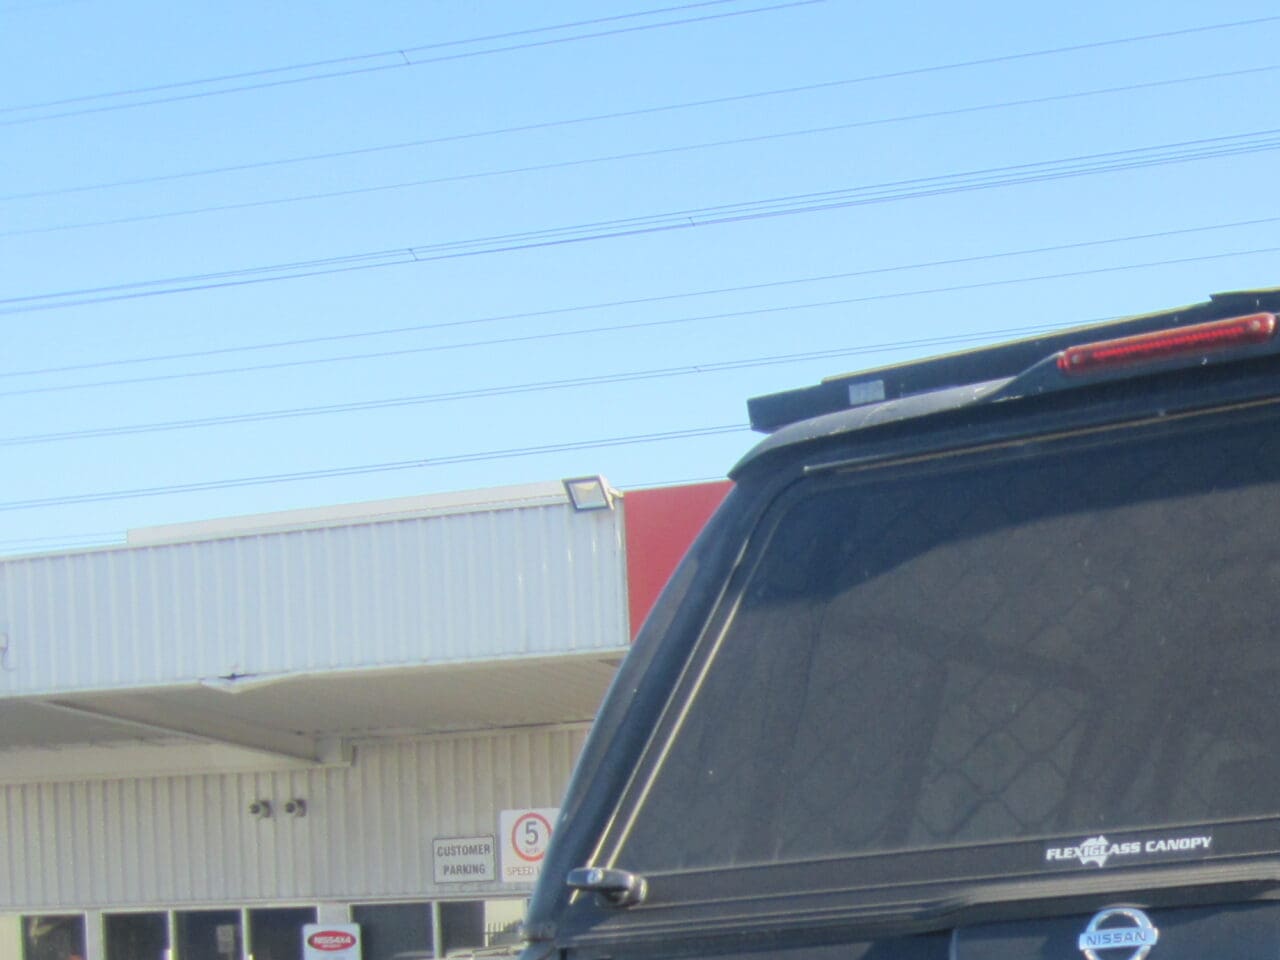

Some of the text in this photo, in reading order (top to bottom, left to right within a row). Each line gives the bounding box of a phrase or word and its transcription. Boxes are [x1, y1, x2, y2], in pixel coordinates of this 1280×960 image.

[525, 821, 539, 846] 5
[437, 844, 490, 857] CUSTOMER
[1046, 836, 1212, 861] FLEXIGLASS CANOPY
[443, 864, 486, 876] PARKING
[506, 864, 535, 876] SPEED
[1086, 931, 1147, 946] NISSAN
